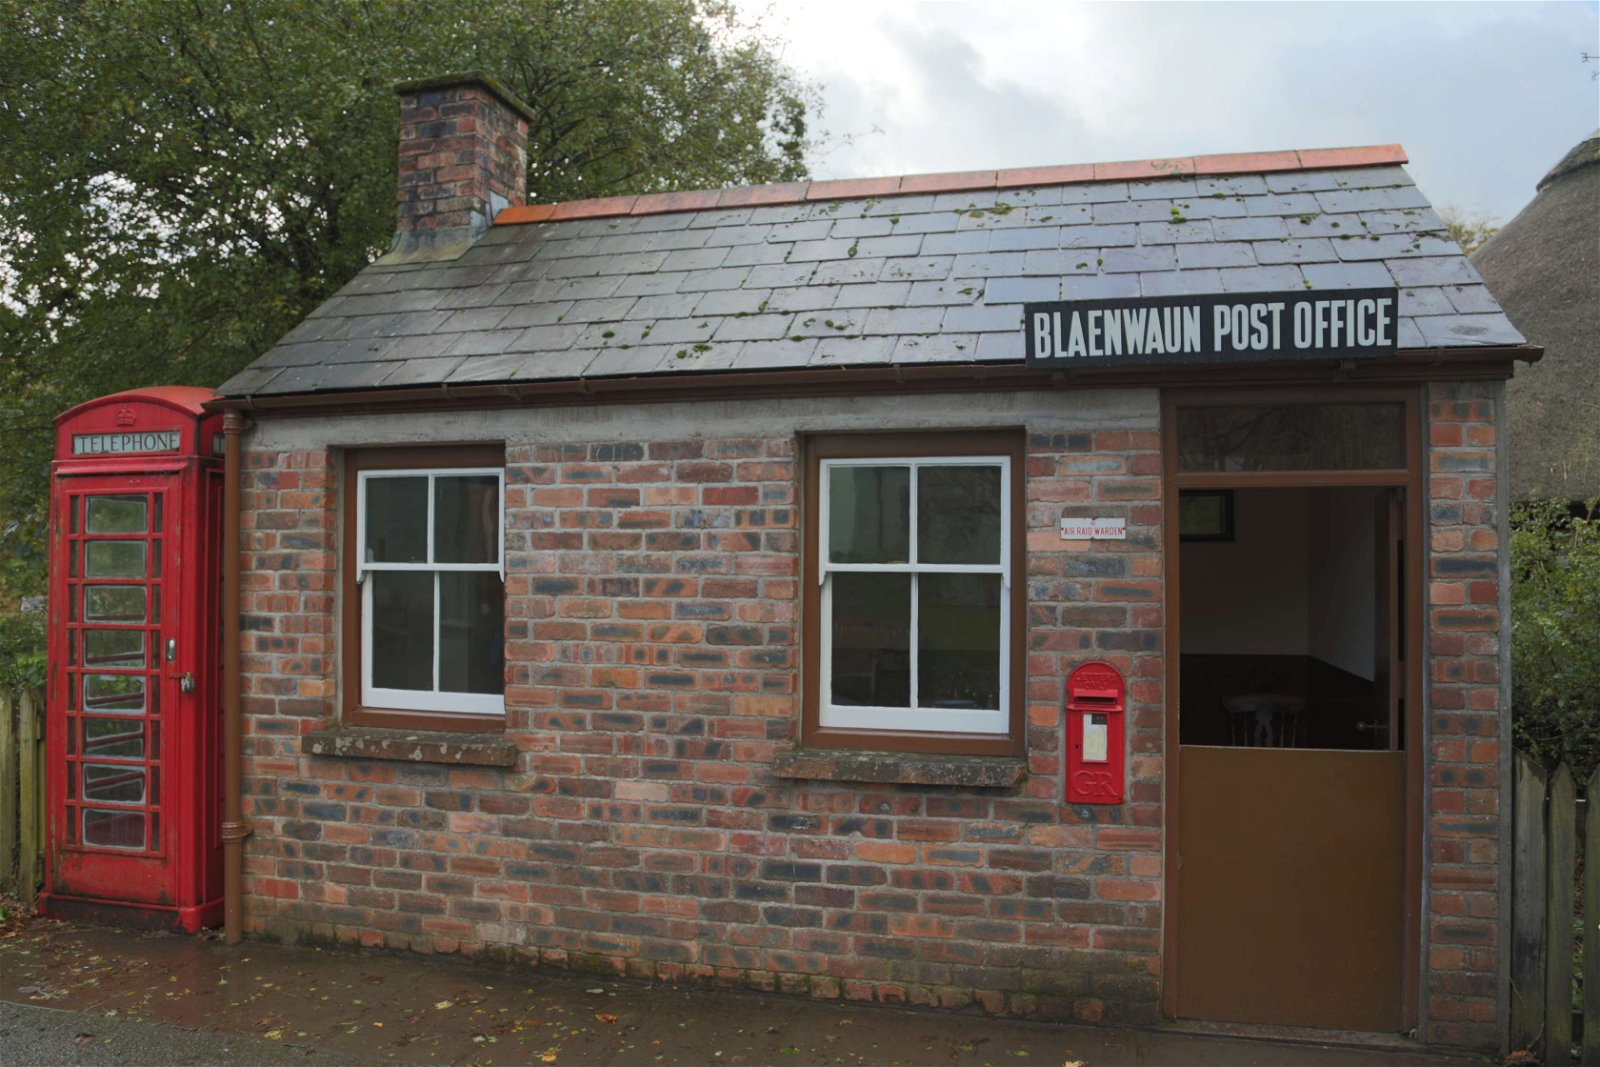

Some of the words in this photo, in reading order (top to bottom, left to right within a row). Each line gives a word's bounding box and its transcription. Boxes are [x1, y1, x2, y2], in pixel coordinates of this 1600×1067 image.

[1033, 305, 1201, 359] BLAENWAUN
[1213, 301, 1286, 352] POST
[1293, 297, 1393, 348] OFFICE
[79, 432, 179, 453] TELEPHONE
[1064, 527, 1075, 535] AIR
[1077, 527, 1093, 535] RAID
[1094, 527, 1123, 535] WARDEN
[1072, 770, 1118, 796] GR
